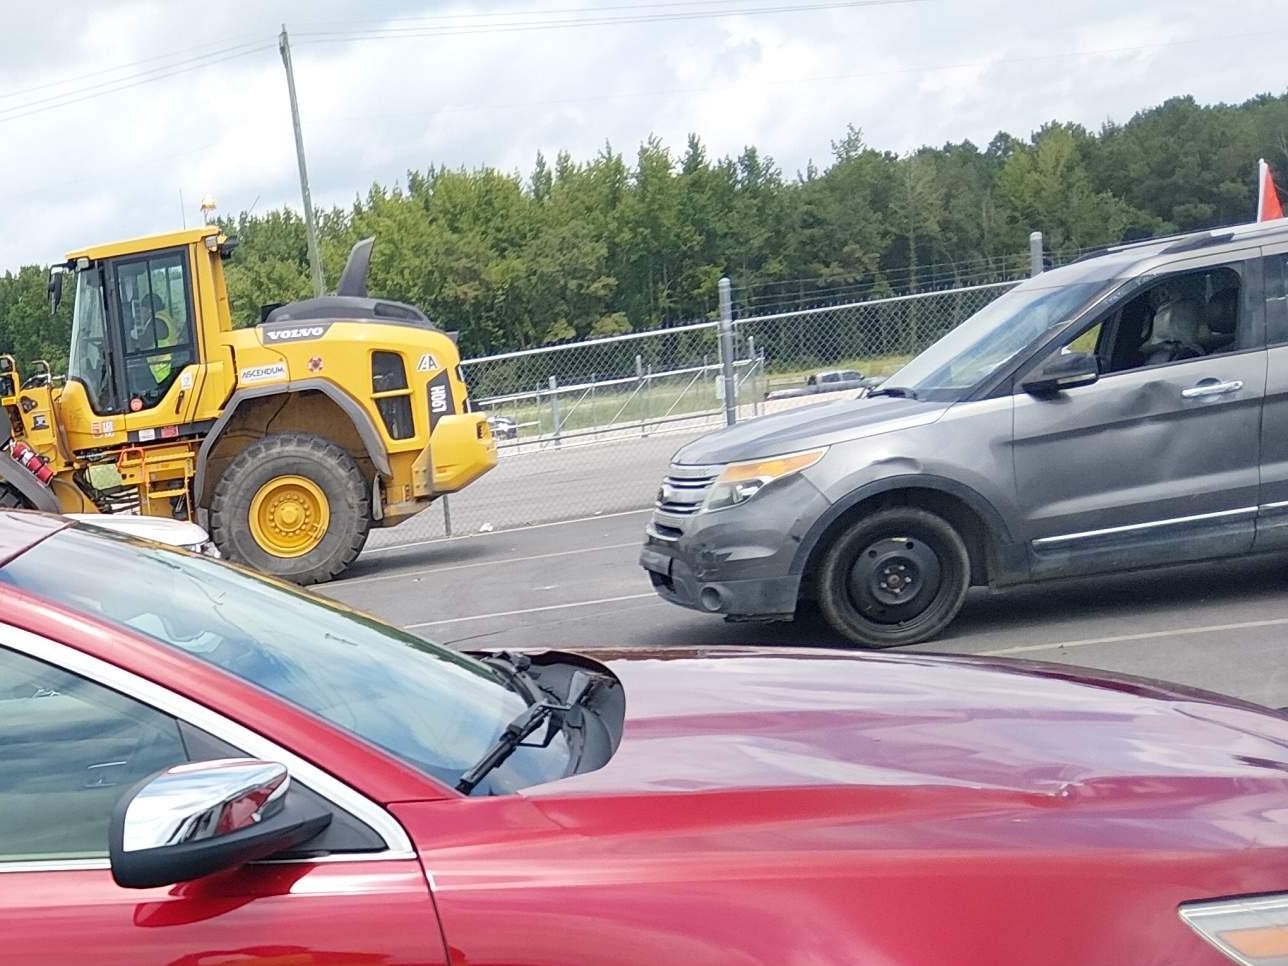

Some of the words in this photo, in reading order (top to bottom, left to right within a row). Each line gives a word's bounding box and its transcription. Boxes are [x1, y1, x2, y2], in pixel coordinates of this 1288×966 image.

[267, 327, 324, 340] VOLVO
[242, 366, 285, 378] ASCENDUM
[430, 385, 448, 413] L90H
